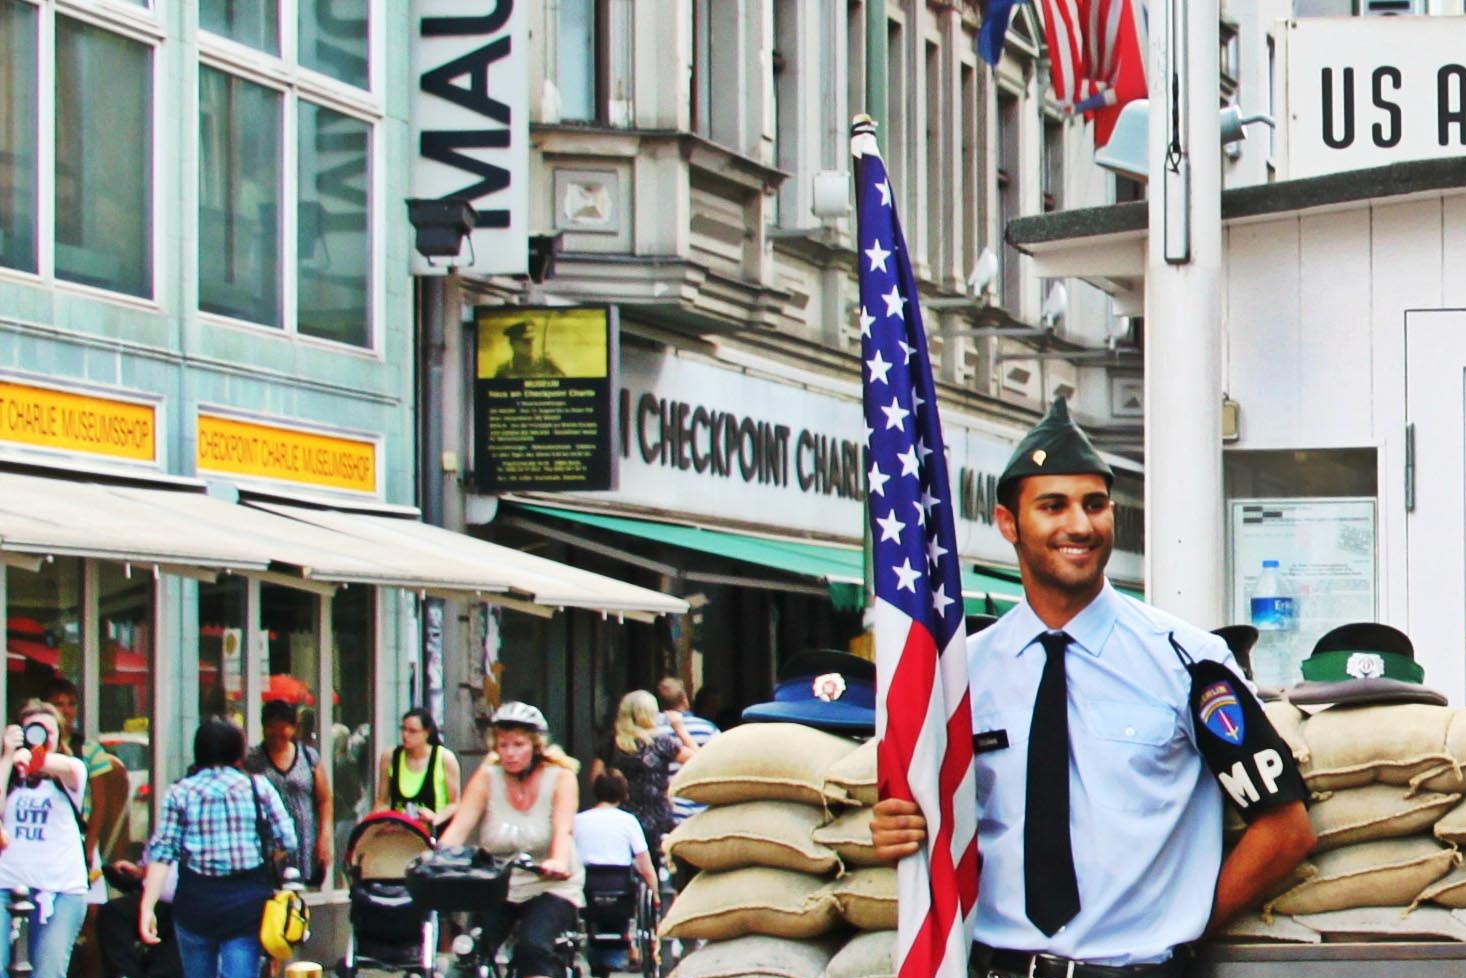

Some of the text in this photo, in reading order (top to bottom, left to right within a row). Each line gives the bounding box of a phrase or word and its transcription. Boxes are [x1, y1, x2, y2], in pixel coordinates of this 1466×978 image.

[1321, 66, 1402, 149] US
[637, 391, 791, 488] CHECKPOINT
[795, 427, 865, 502] CHARL
[1217, 747, 1285, 809] MP
[15, 826, 46, 841] FUL
